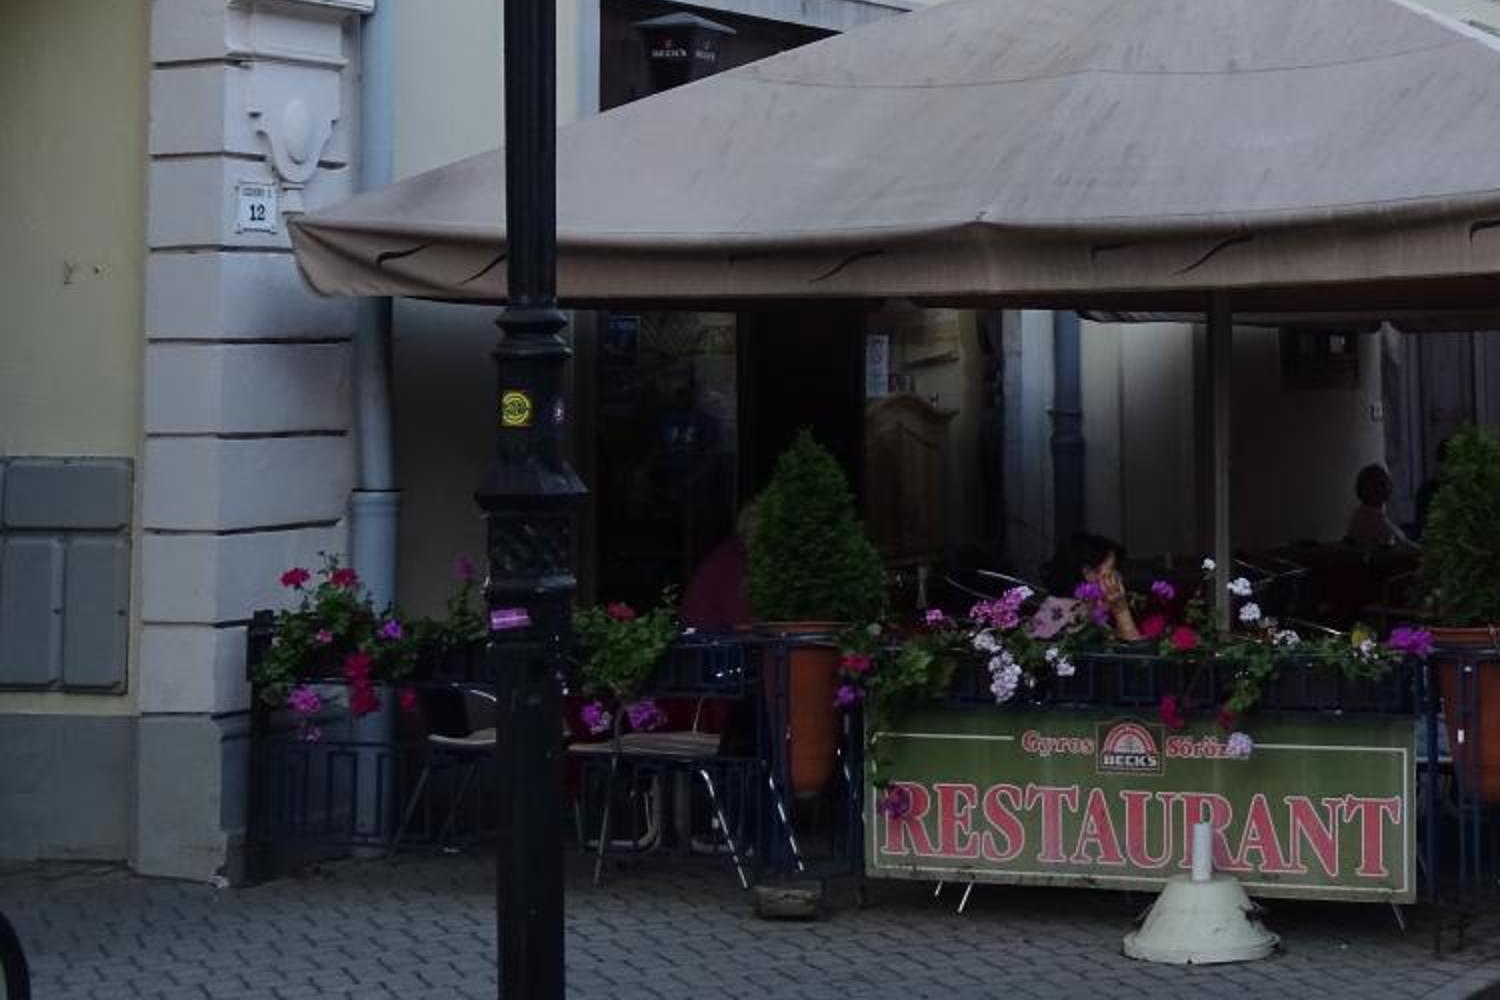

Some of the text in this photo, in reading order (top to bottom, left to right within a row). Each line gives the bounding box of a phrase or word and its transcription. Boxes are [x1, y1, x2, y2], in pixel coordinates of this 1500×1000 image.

[249, 204, 266, 221] 12
[1021, 729, 1250, 760] Gyros Söröz
[880, 781, 1402, 877] RESTAURANT
